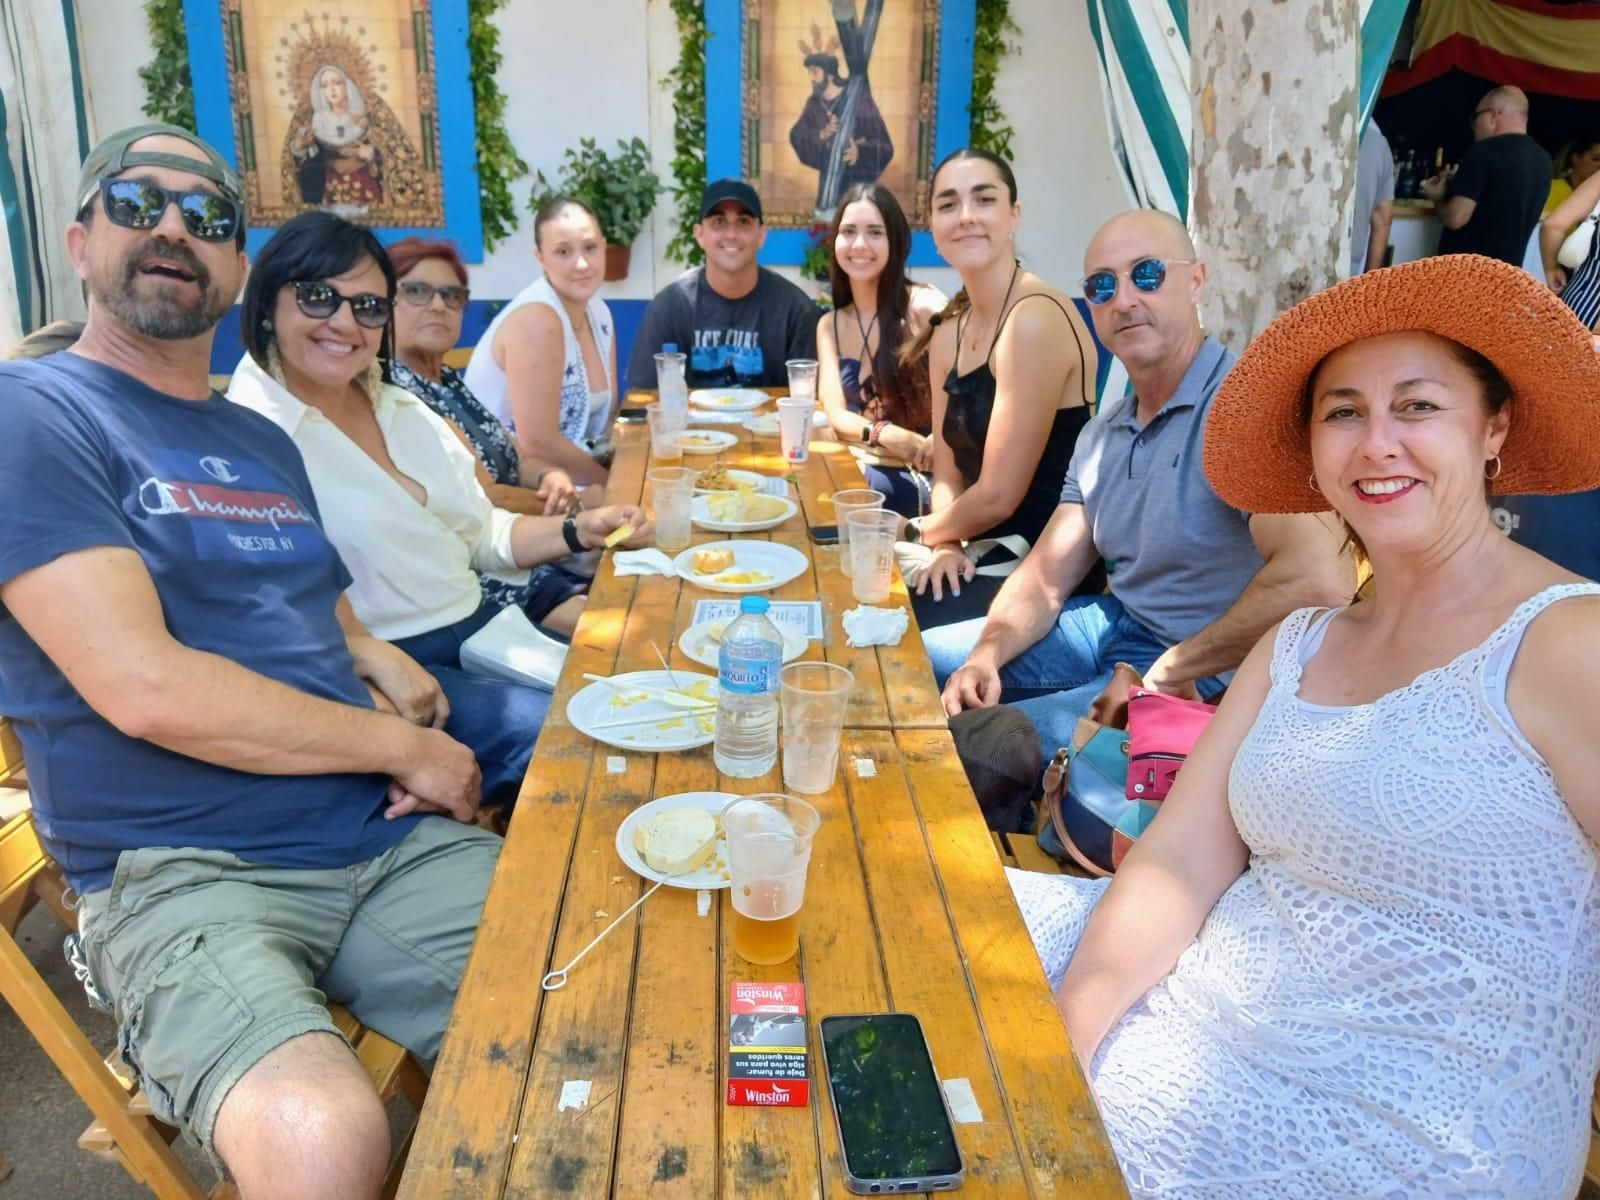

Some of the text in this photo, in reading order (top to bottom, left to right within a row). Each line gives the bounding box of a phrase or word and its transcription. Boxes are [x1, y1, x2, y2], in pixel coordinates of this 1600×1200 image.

[694, 330, 721, 350] ICE
[279, 536, 295, 551] NY
[736, 989, 784, 1001] Winston
[788, 1061, 805, 1069] siga
[747, 1068, 773, 1077] fumar:
[787, 1068, 805, 1077] Deje
[745, 1088, 790, 1103] Winston
